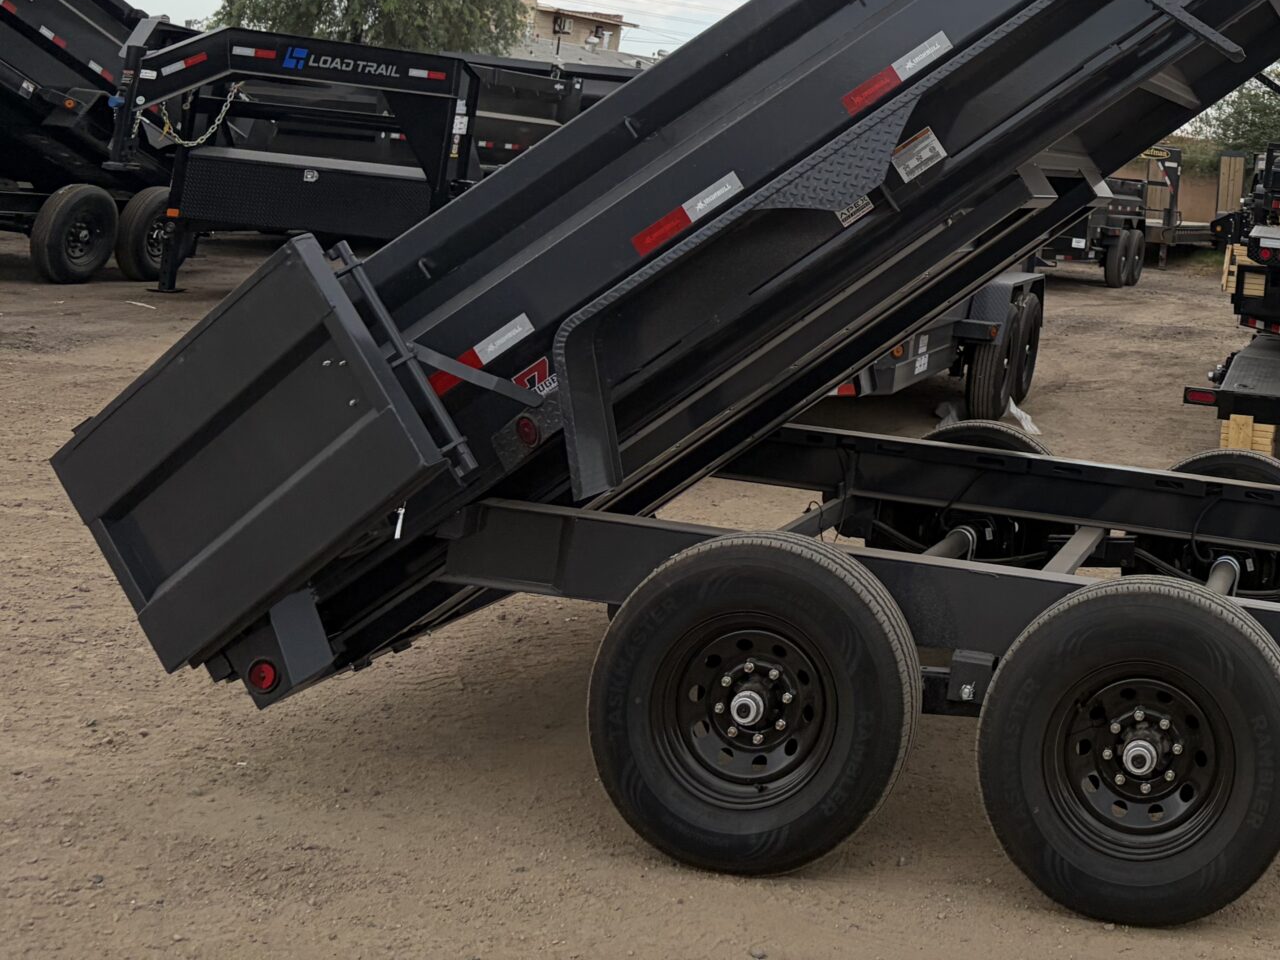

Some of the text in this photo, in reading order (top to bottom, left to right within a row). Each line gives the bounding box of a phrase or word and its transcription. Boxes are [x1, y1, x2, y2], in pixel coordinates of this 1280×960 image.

[308, 54, 400, 78] LOAD TRAIL
[1249, 713, 1275, 830] RAMBLER
